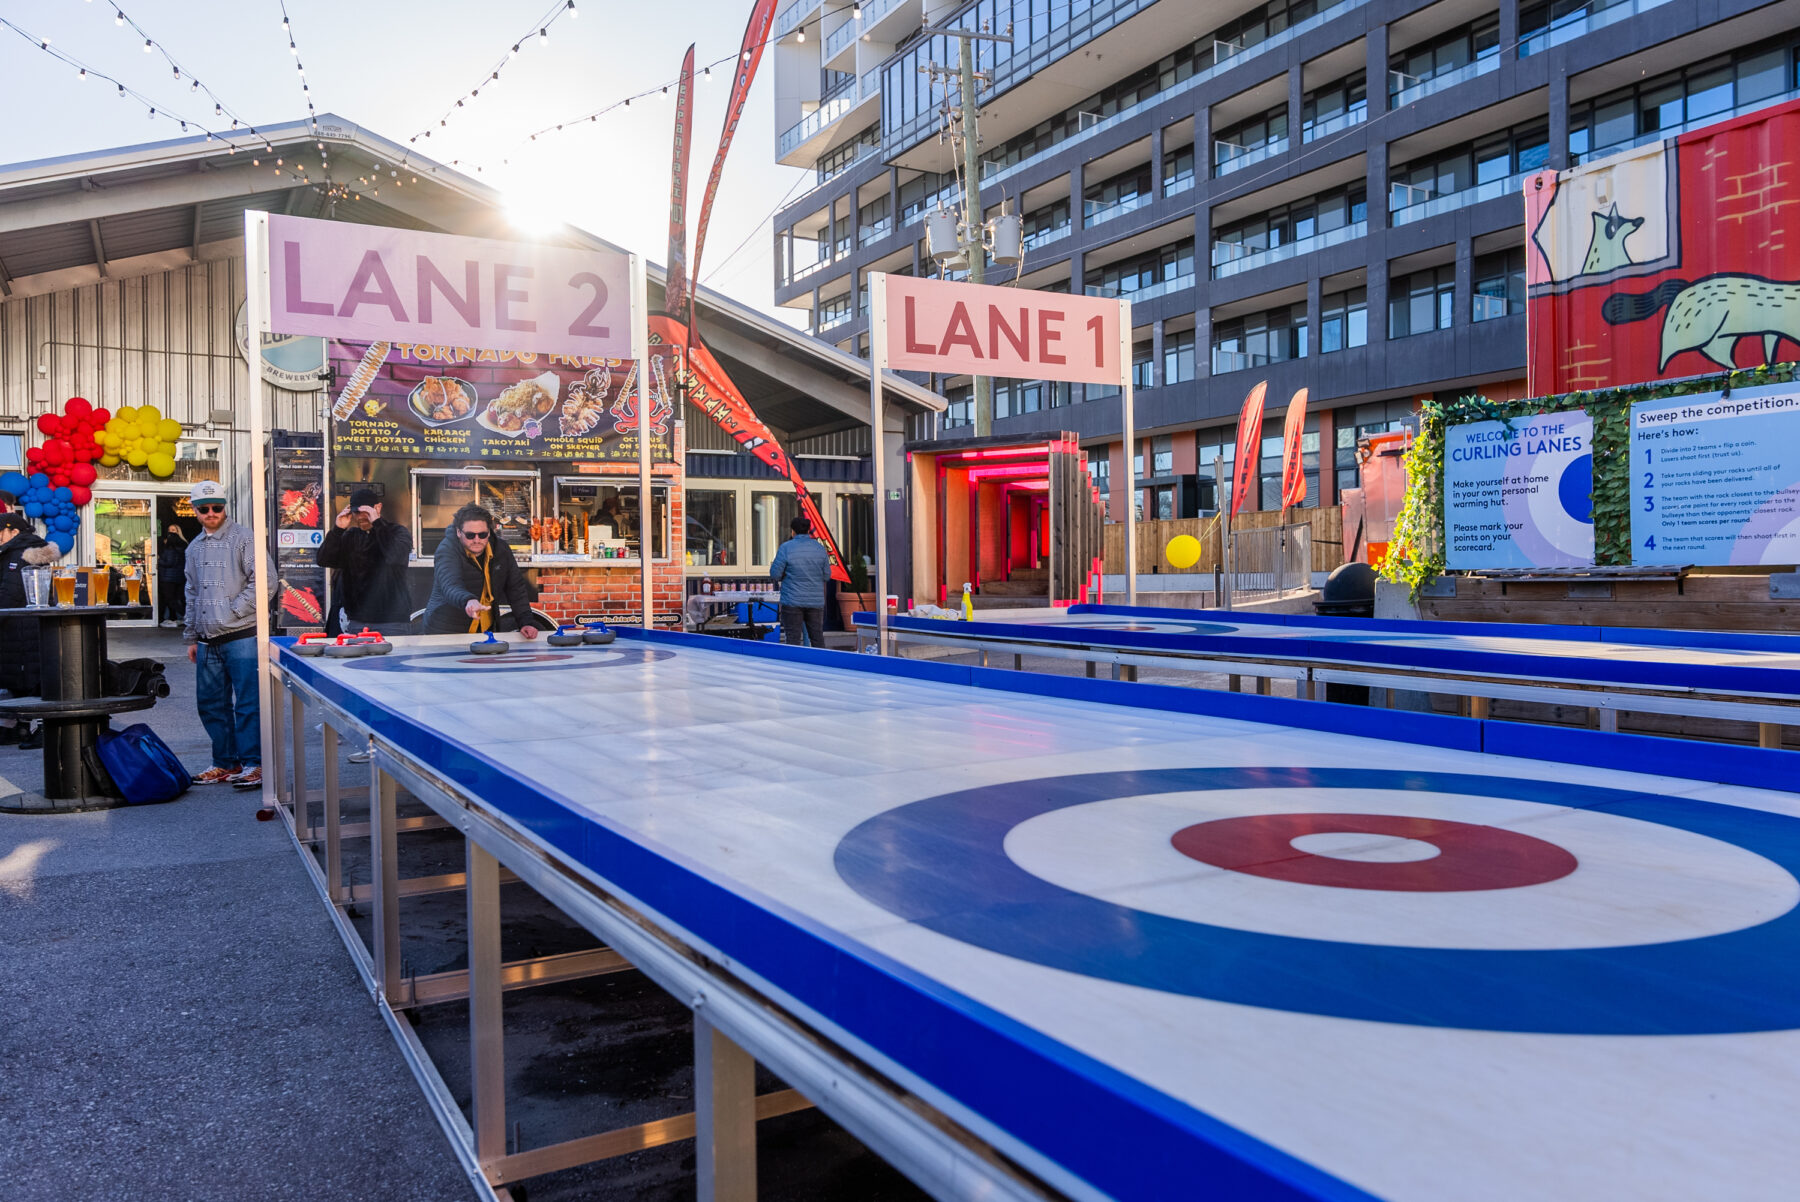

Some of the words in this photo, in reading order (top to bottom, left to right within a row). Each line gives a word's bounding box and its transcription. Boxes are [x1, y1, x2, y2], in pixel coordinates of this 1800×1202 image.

[284, 241, 537, 333] LANE
[568, 270, 611, 339] 2
[904, 295, 1067, 366] LANE
[1086, 315, 1104, 368] 1
[397, 342, 538, 364] TORNADO
[1640, 411, 1678, 424] Sweep
[1681, 408, 1703, 418] the
[1707, 396, 1800, 416] competition.
[349, 420, 398, 428] TORNADO
[1523, 427, 1538, 438] TO
[1542, 424, 1565, 436] THE
[424, 428, 472, 436] KARAAGE
[1638, 430, 1670, 441] Here's
[1672, 428, 1699, 437] how:
[424, 436, 466, 444] CHICKEN
[1452, 442, 1521, 462] CURLING
[1528, 436, 1582, 456] LANES
[1644, 448, 1652, 464] 1
[1453, 480, 1474, 488] Make
[1476, 476, 1508, 489] yourself
[1524, 475, 1549, 484] home
[1644, 472, 1654, 488] 2
[1453, 490, 1460, 499] in
[1462, 490, 1480, 500] your
[1502, 486, 1539, 498] personal
[1453, 500, 1488, 509] warming
[1490, 498, 1508, 506] hut.
[1644, 496, 1655, 512] 3
[1454, 524, 1478, 532] Please
[1480, 522, 1502, 530] mark
[1504, 523, 1524, 532] your
[1454, 534, 1478, 544] points
[1492, 534, 1512, 543] your
[1644, 534, 1656, 550] 4
[1454, 543, 1496, 552] scorecard.
